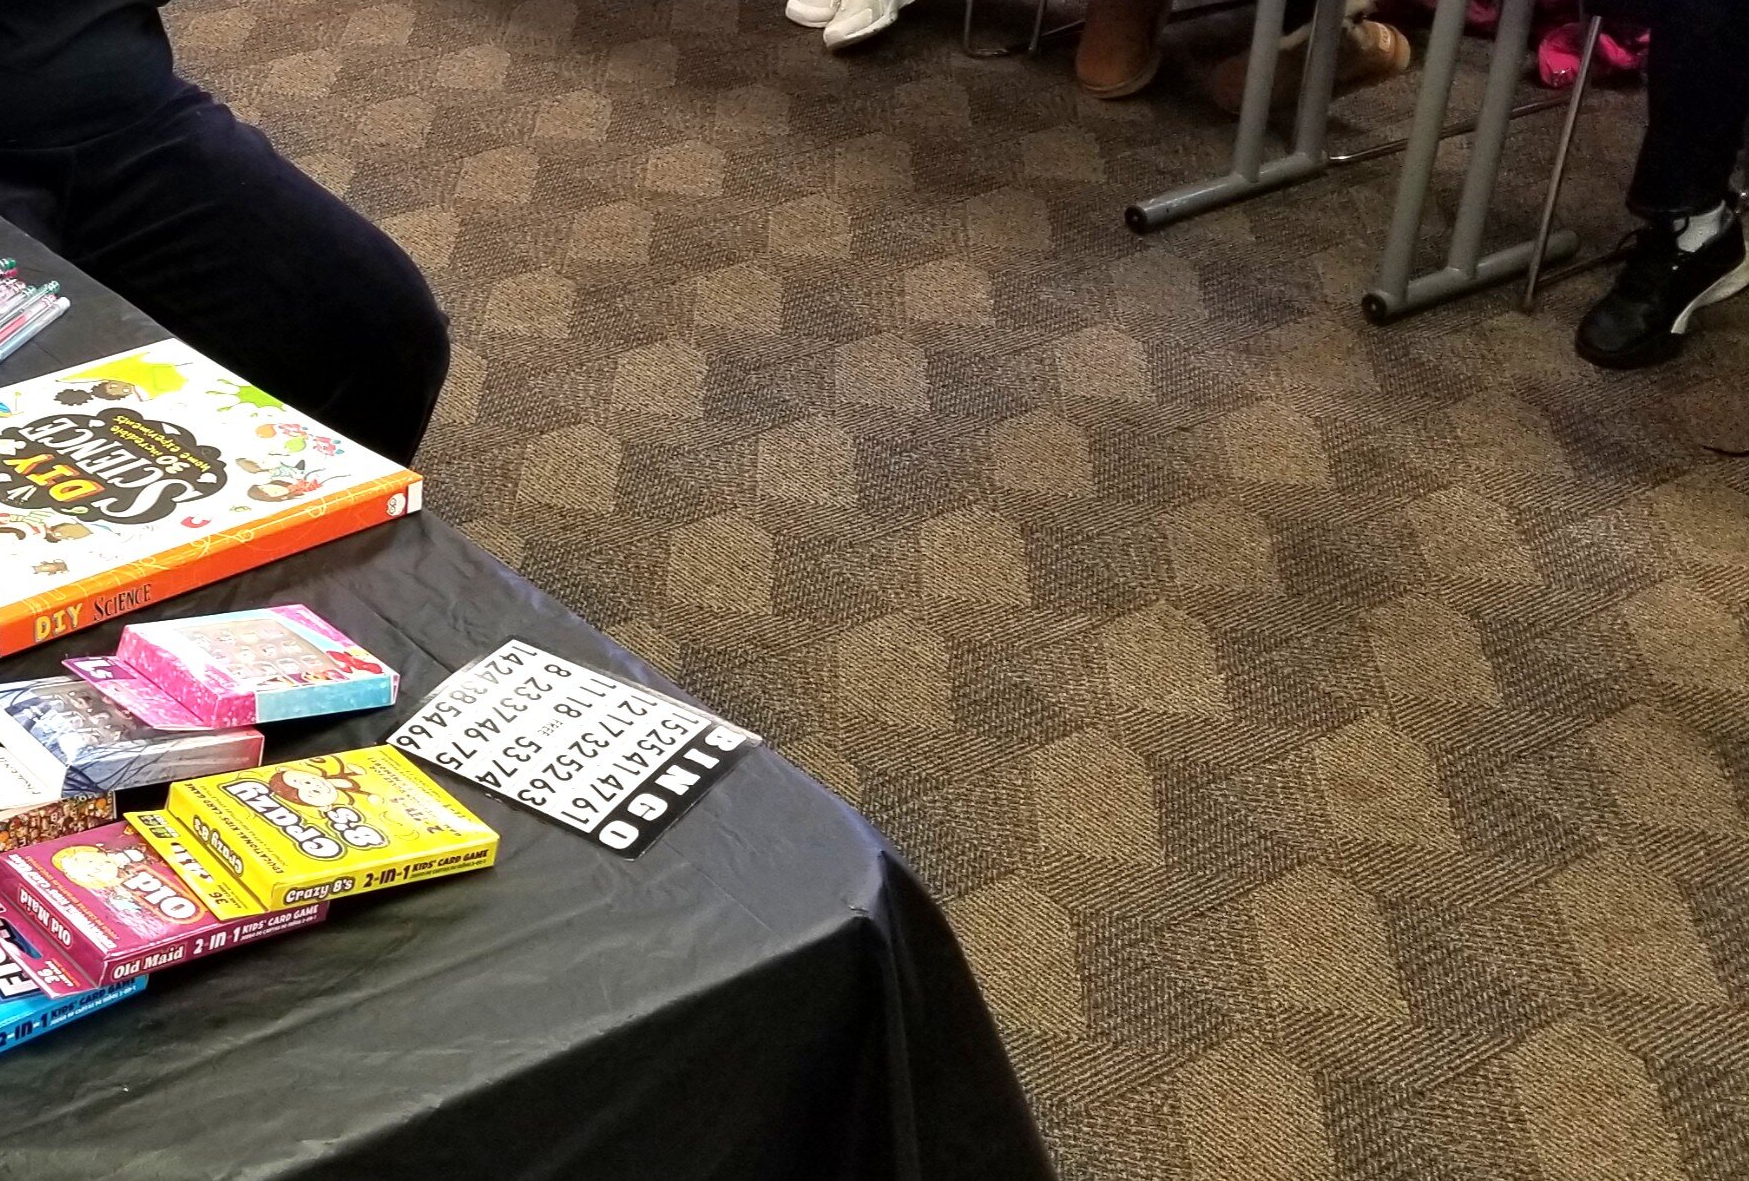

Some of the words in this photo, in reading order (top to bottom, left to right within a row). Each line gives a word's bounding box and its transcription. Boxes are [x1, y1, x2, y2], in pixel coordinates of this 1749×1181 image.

[111, 425, 163, 458] incredible
[113, 415, 182, 453] experiments
[18, 417, 204, 519] SCIENCE
[155, 455, 191, 474] 30
[179, 451, 212, 473] home
[3, 453, 106, 503] DIY
[92, 583, 152, 621] SCIENCE
[35, 603, 84, 643] DIY
[498, 645, 537, 667] 14
[473, 660, 513, 685] 24
[543, 663, 571, 678] 8
[448, 680, 488, 704] 38
[512, 676, 553, 701] 23
[578, 678, 617, 699] 11
[422, 700, 462, 728] 54
[492, 697, 528, 724] 37
[554, 696, 593, 718] 18
[617, 695, 657, 718] 12
[396, 723, 433, 750] 66
[464, 717, 501, 743] 46
[536, 718, 564, 737] FREE
[598, 714, 634, 739] 17
[661, 712, 699, 737] 15
[436, 741, 477, 771] 75
[503, 736, 542, 763] 53
[570, 732, 609, 759] 32
[637, 730, 674, 756] 25
[475, 760, 519, 788] 74
[543, 754, 583, 781] 52
[613, 752, 650, 778] 41
[184, 783, 203, 799] GAME
[518, 778, 557, 806] 63
[590, 774, 624, 803] 47
[204, 800, 222, 817] CARD
[224, 780, 343, 859] Crazy
[561, 797, 599, 825] 61
[193, 817, 209, 843] 8's
[222, 817, 239, 832] KIDS'
[327, 806, 387, 847] 8's
[210, 829, 243, 876] Crazy
[238, 832, 284, 874] EDUCATIONAL
[363, 864, 411, 888] 2-IN-1
[413, 860, 437, 873] KIDS'
[437, 854, 461, 868] CARD
[463, 849, 489, 864] GAME
[124, 871, 196, 919] Old
[208, 891, 230, 906] 36
[286, 882, 329, 905] Crazy
[332, 877, 353, 894] 8's
[20, 888, 51, 924] Maid
[51, 924, 71, 946] Old
[193, 927, 241, 955] 2-IN-1
[242, 920, 266, 935] KIDS'
[268, 913, 292, 927] CARD
[294, 904, 318, 921] GAME
[113, 960, 140, 979] Old
[143, 945, 184, 970] Maid
[51, 999, 78, 1019] KIDS'
[79, 989, 106, 1007] CARD
